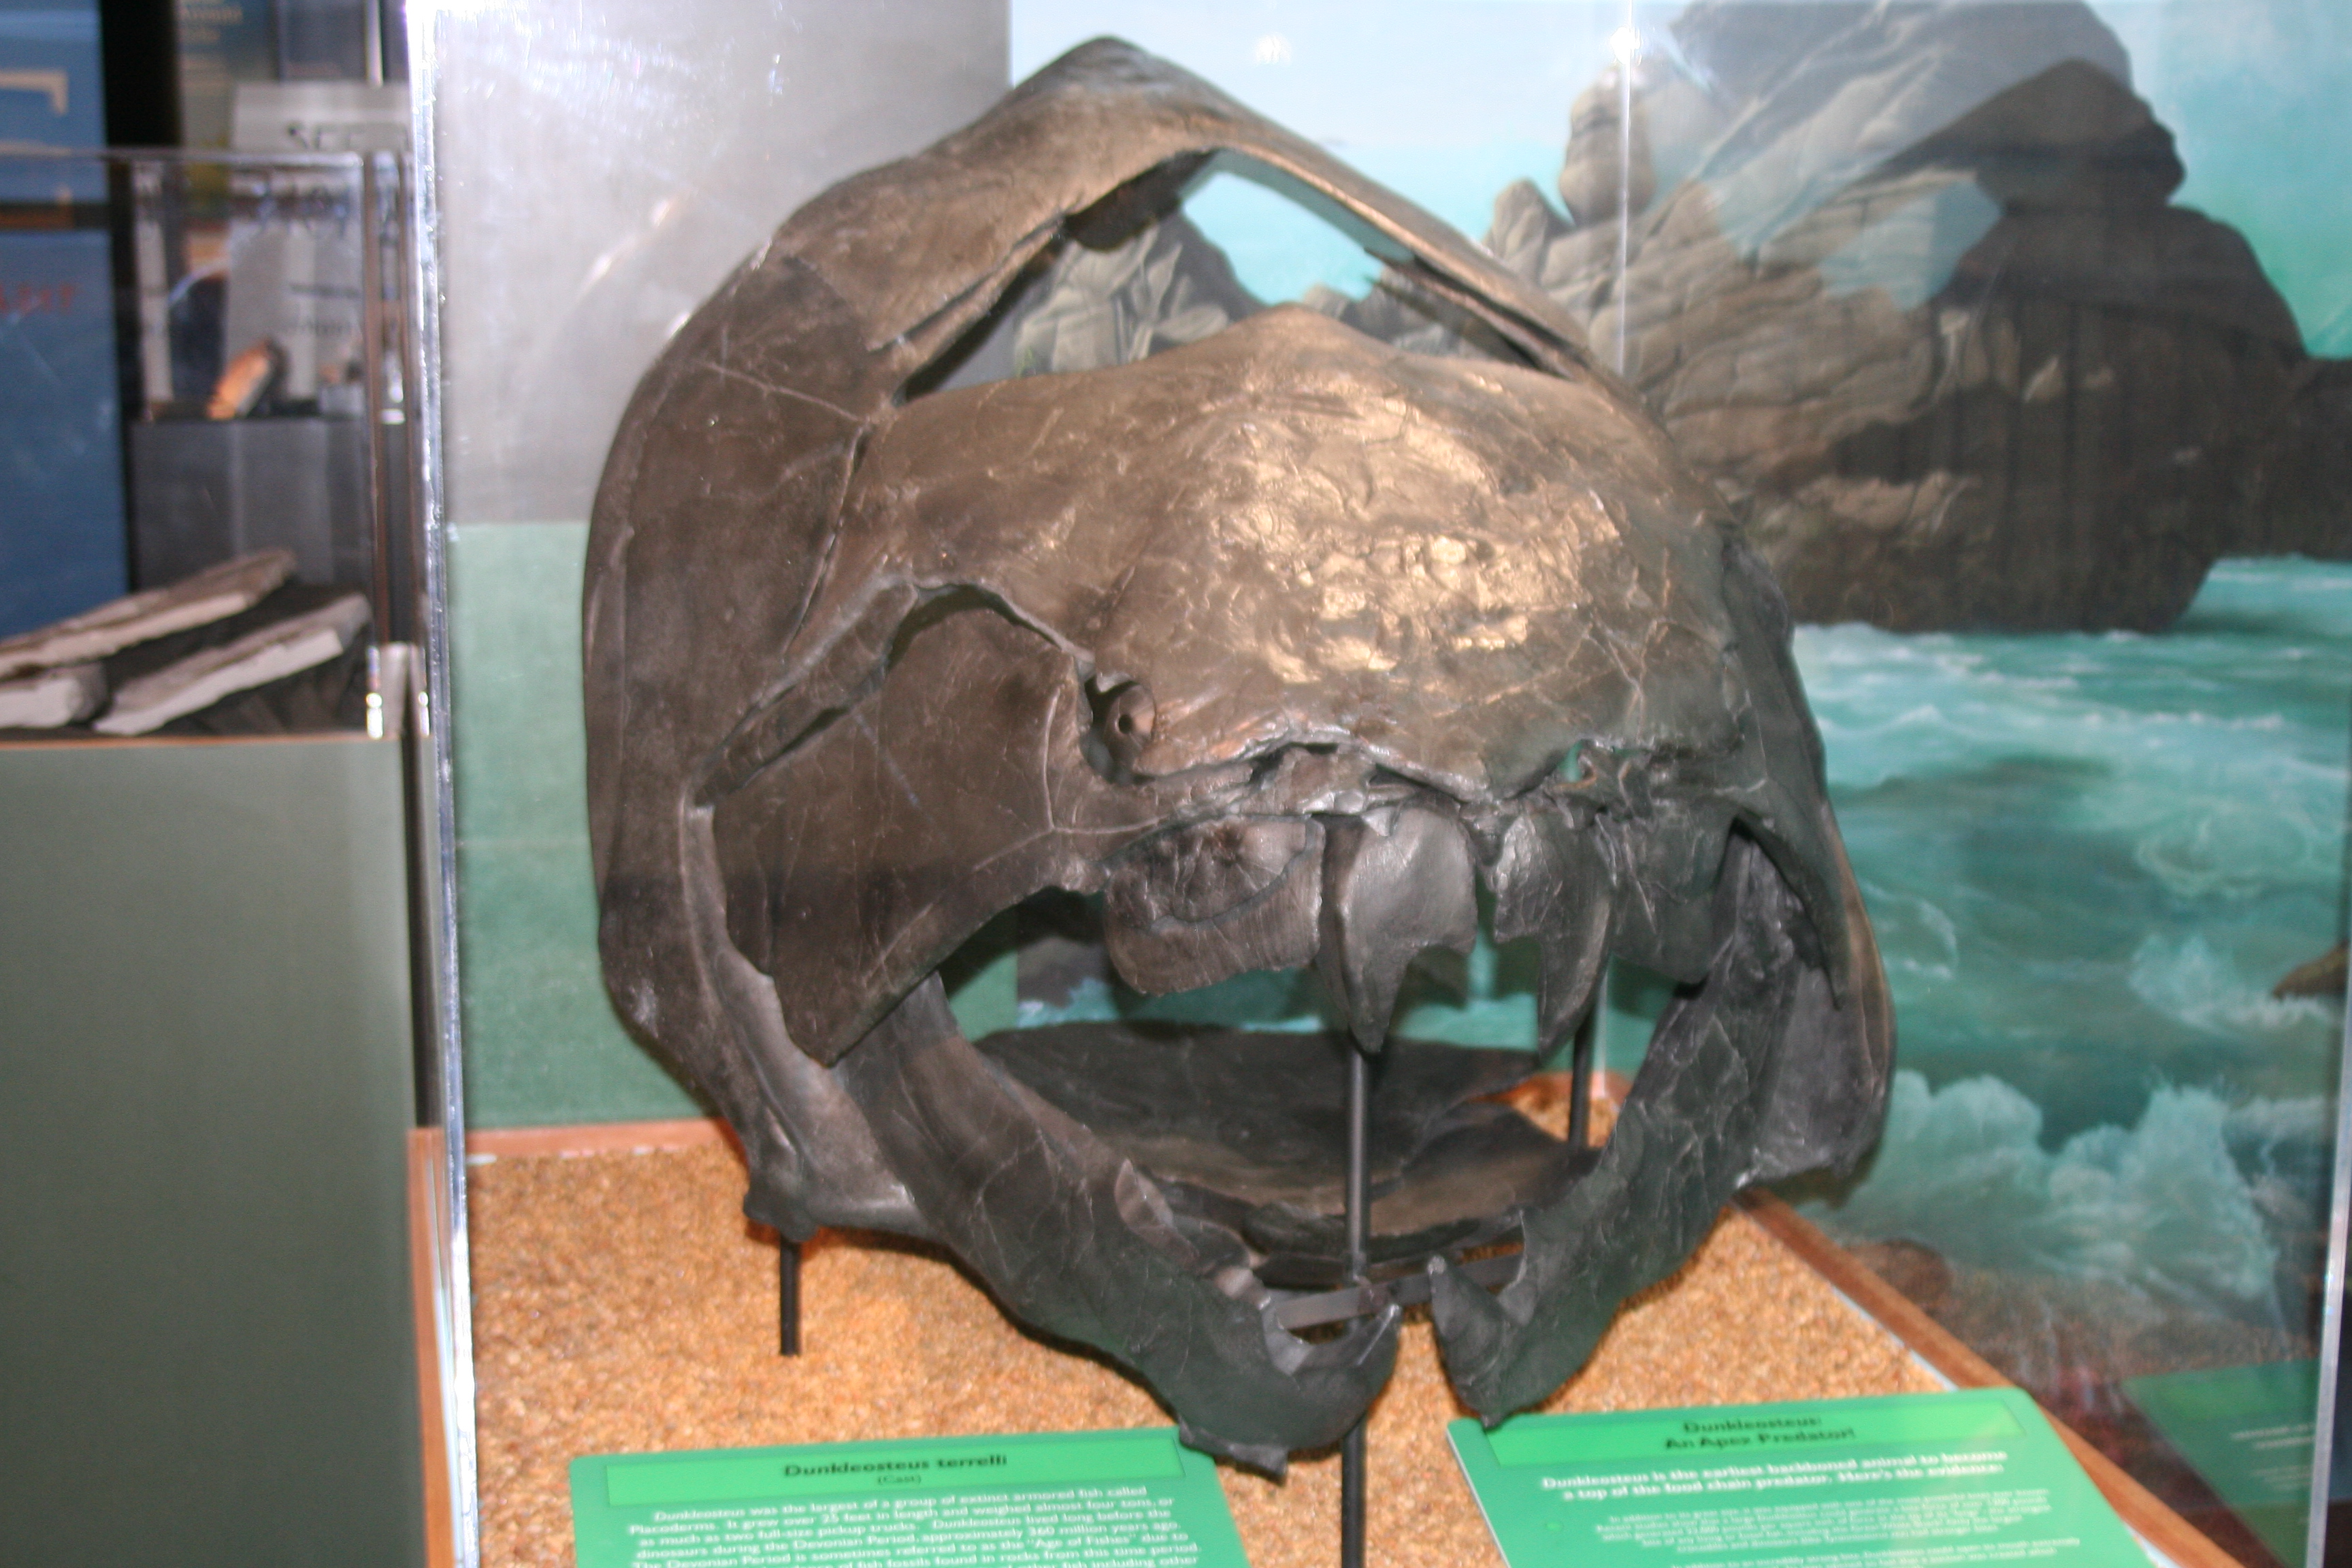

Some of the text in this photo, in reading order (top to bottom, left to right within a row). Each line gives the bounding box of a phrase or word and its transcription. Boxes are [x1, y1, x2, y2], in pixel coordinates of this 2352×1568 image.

[1666, 1439, 1694, 1449] An
[785, 1454, 1007, 1476] Dunkleosteus terrelli
[1542, 1474, 1648, 1488] Dunkleosteus
[1653, 1471, 1666, 1481] is
[1670, 1470, 1698, 1480] the
[877, 1474, 921, 1486] (Cast)
[1565, 1492, 1574, 1501] a
[1578, 1490, 1606, 1501] top
[1612, 1488, 1628, 1497] of
[1633, 1486, 1660, 1496] the
[1896, 1470, 1923, 1480] the
[653, 1508, 745, 1522] Dunkleosteus
[750, 1507, 777, 1516] was
[782, 1503, 805, 1515] the
[811, 1501, 858, 1514] largest
[863, 1499, 877, 1511] of
[881, 1501, 889, 1510] a
[894, 1499, 936, 1512] group
[941, 1496, 955, 1507] of
[1079, 1488, 1102, 1501] fish
[1107, 1486, 1147, 1499] called
[726, 1518, 738, 1529] It
[742, 1518, 778, 1530] grew
[783, 1516, 814, 1526] over
[843, 1511, 871, 1522] feet
[877, 1510, 889, 1521] in
[943, 1506, 968, 1518] and
[972, 1503, 1030, 1517] weighed
[1035, 1501, 1081, 1514] almost
[636, 1548, 707, 1560] dinosaurs
[713, 1544, 760, 1556] during
[764, 1541, 787, 1553] the
[793, 1538, 862, 1551] Devonian
[923, 1529, 1022, 1546] approximately
[1059, 1524, 1106, 1537] million
[1111, 1524, 1148, 1536] years
[640, 1538, 655, 1548] as
[659, 1534, 700, 1546] much
[704, 1535, 720, 1544] as
[724, 1532, 753, 1543] two
[818, 1526, 865, 1540] pickup
[931, 1518, 1020, 1532] Dunkleosteus
[1026, 1515, 1058, 1527] lived
[1062, 1514, 1093, 1526] long
[1097, 1512, 1143, 1523] before
[1147, 1509, 1171, 1520] the
[742, 1552, 790, 1565] Period
[795, 1552, 806, 1563] is
[812, 1548, 889, 1562] sometimes
[896, 1544, 956, 1557] referred
[981, 1544, 996, 1553] as
[1000, 1541, 1024, 1552] the
[1067, 1537, 1081, 1548] of
[1141, 1533, 1167, 1544] due
[858, 1558, 882, 1568] fish
[887, 1556, 930, 1568] fossils
[934, 1553, 977, 1566] found
[981, 1552, 994, 1563] in
[1043, 1550, 1079, 1561] from
[1083, 1547, 1109, 1558] this
[1113, 1546, 1145, 1557] time
